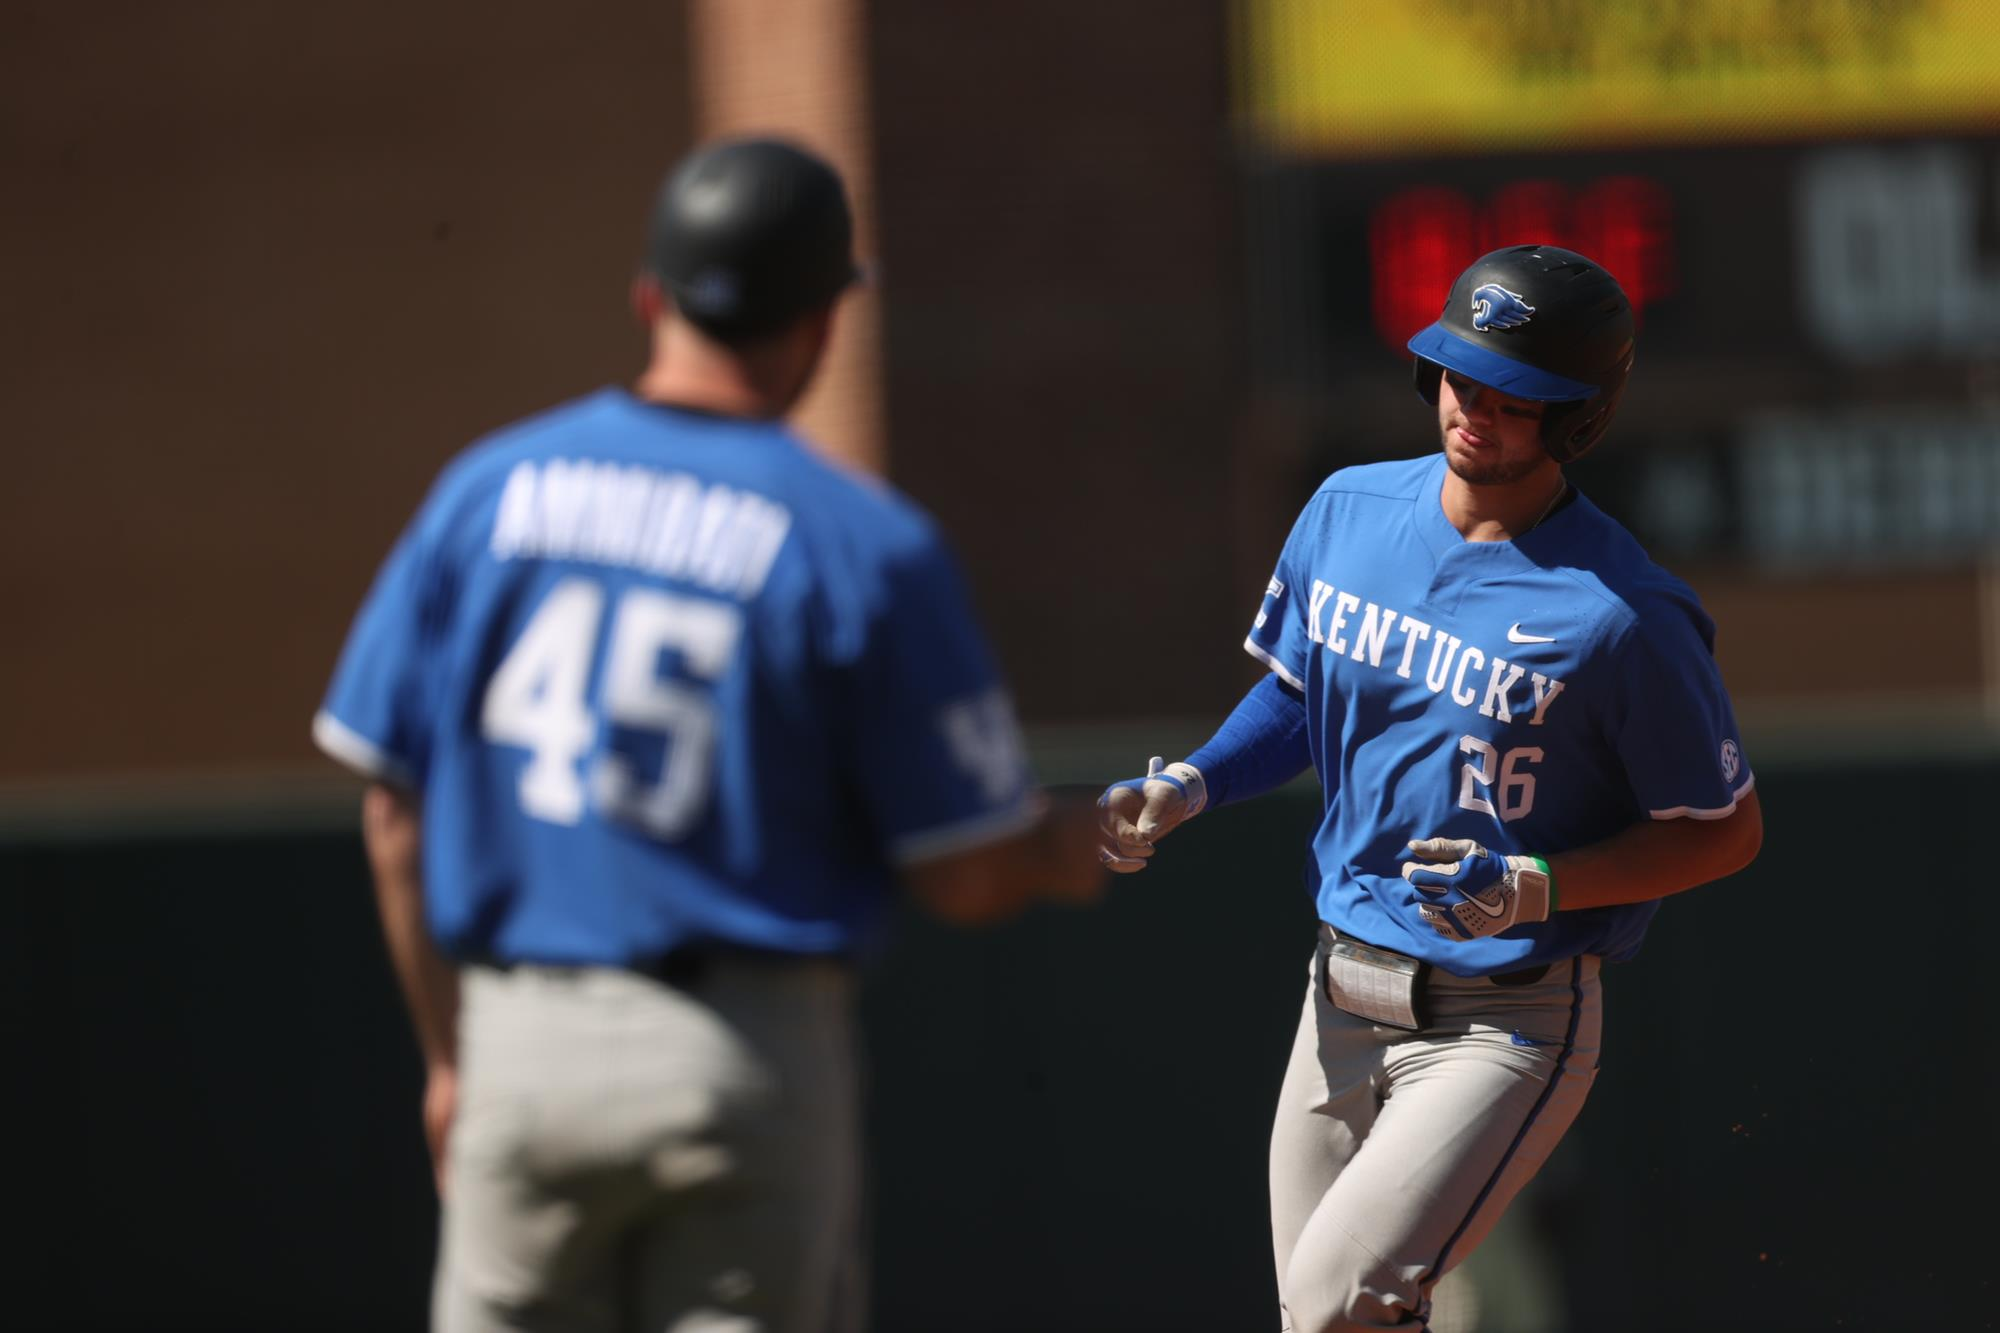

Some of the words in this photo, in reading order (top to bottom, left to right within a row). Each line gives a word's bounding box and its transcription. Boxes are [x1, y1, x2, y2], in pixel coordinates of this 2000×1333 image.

[482, 577, 744, 842] 45
[1308, 579, 1566, 726] KENTUCKY
[1458, 734, 1545, 823] 26
